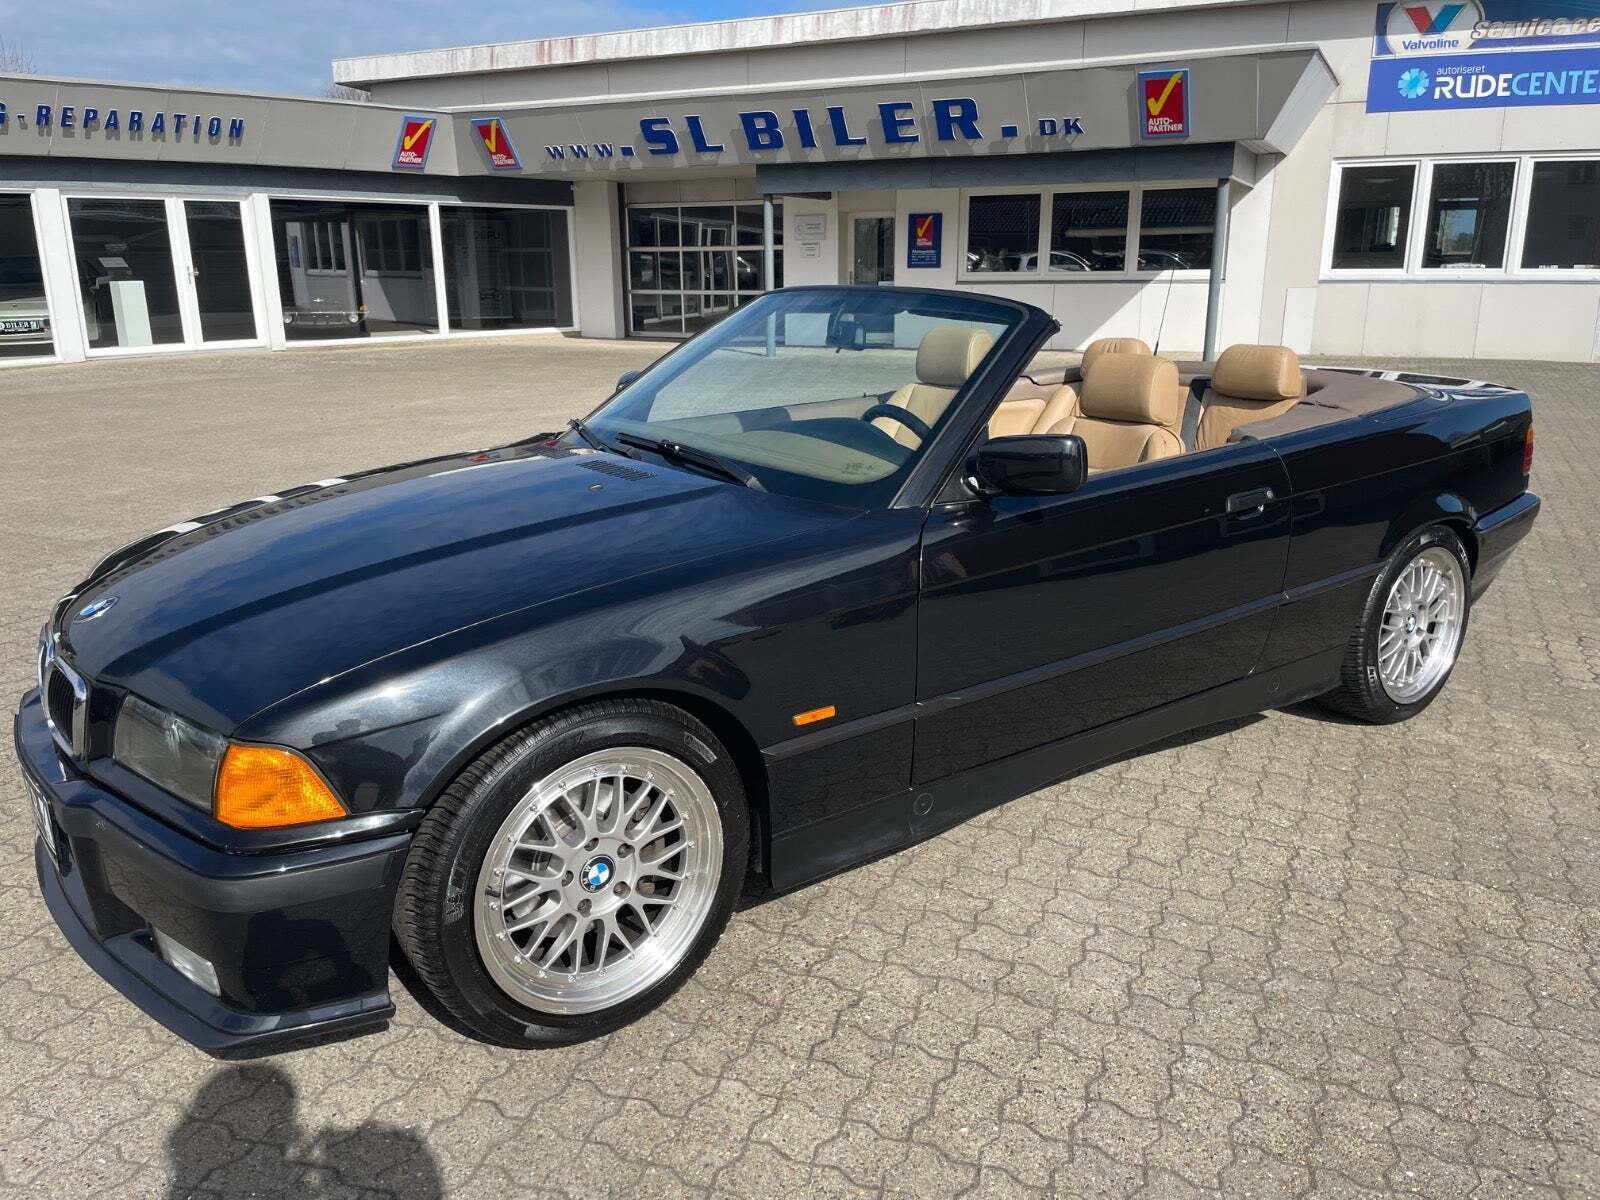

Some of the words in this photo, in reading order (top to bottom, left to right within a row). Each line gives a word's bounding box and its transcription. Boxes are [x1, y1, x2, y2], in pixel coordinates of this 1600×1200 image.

[1402, 38, 1459, 51] Valvoline
[1436, 65, 1485, 75] autoriseret
[1434, 70, 1600, 99] RUDECENTE
[1148, 117, 1173, 125] AUTO-
[1148, 124, 1183, 133] PARTNER
